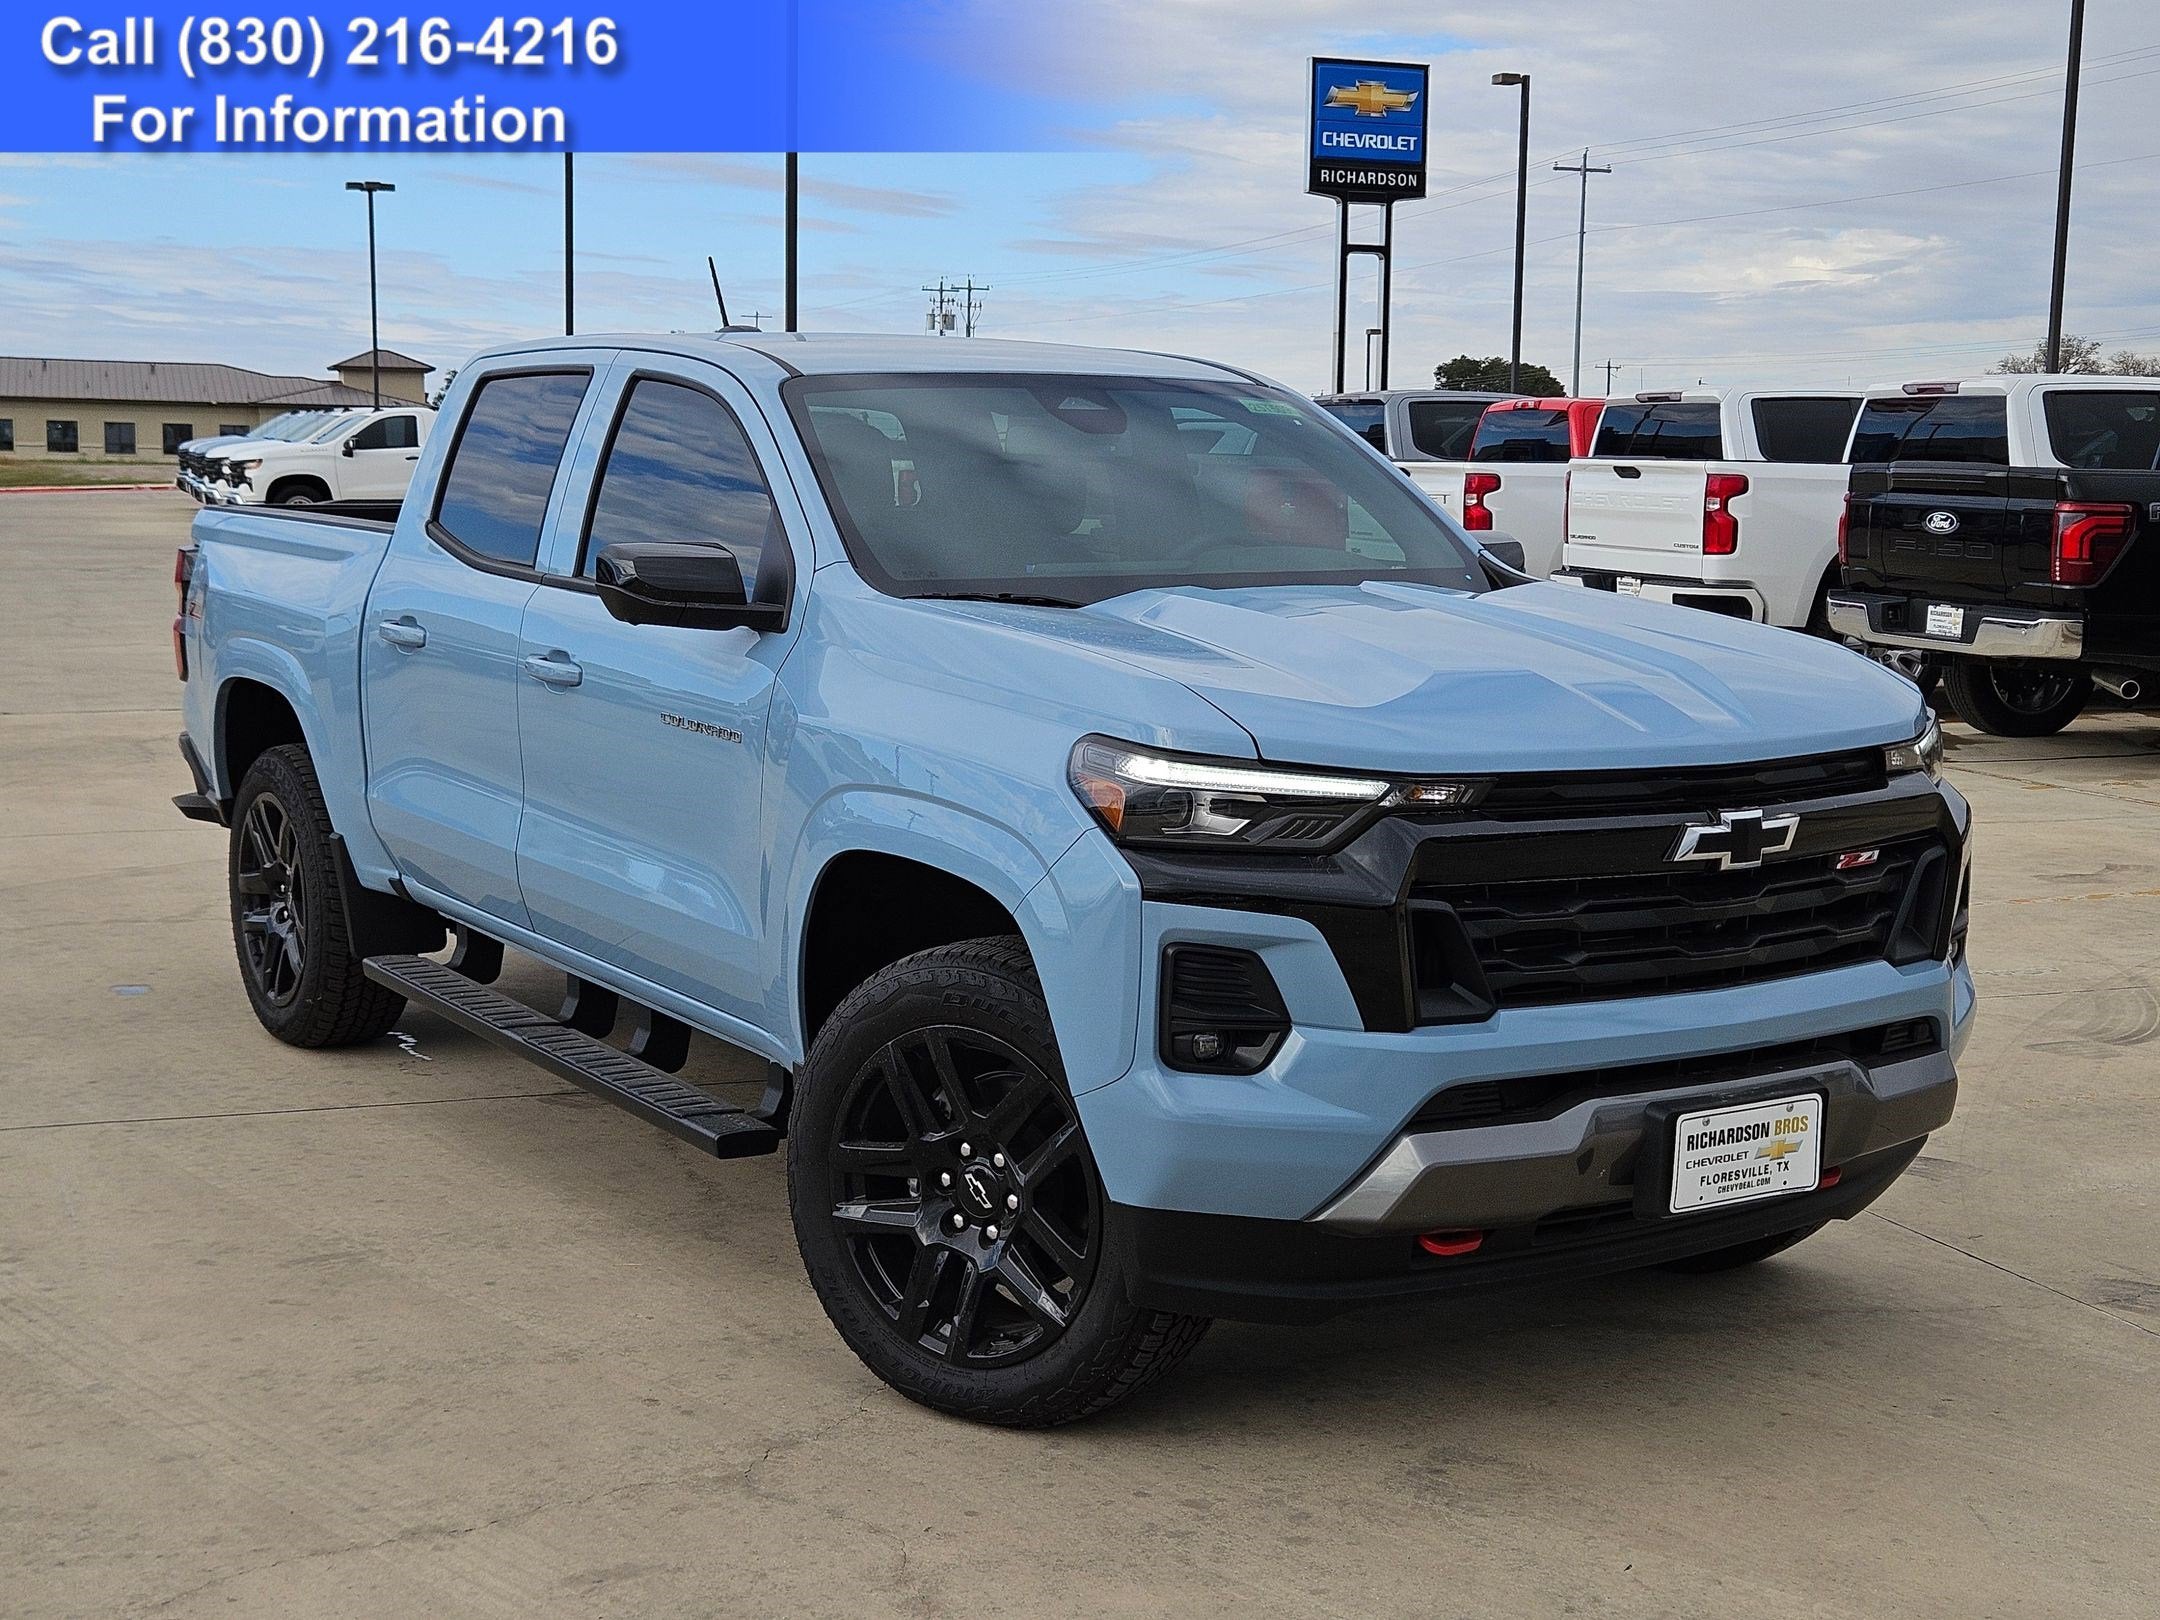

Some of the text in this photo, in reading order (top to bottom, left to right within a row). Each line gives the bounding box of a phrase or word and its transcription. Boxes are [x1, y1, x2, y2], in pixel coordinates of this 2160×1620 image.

[1322, 131, 1418, 151] CHEVROLET
[1320, 169, 1418, 187] RICHARDSON
[660, 711, 743, 744] COLORADO
[1687, 1115, 1809, 1152] RICHARDSON BROS
[1685, 1150, 1750, 1170] CHEVROLET
[1700, 1160, 1790, 1187] FLORESVILLE, TX
[1717, 1177, 1771, 1194] CHEVYDEAL.COM
